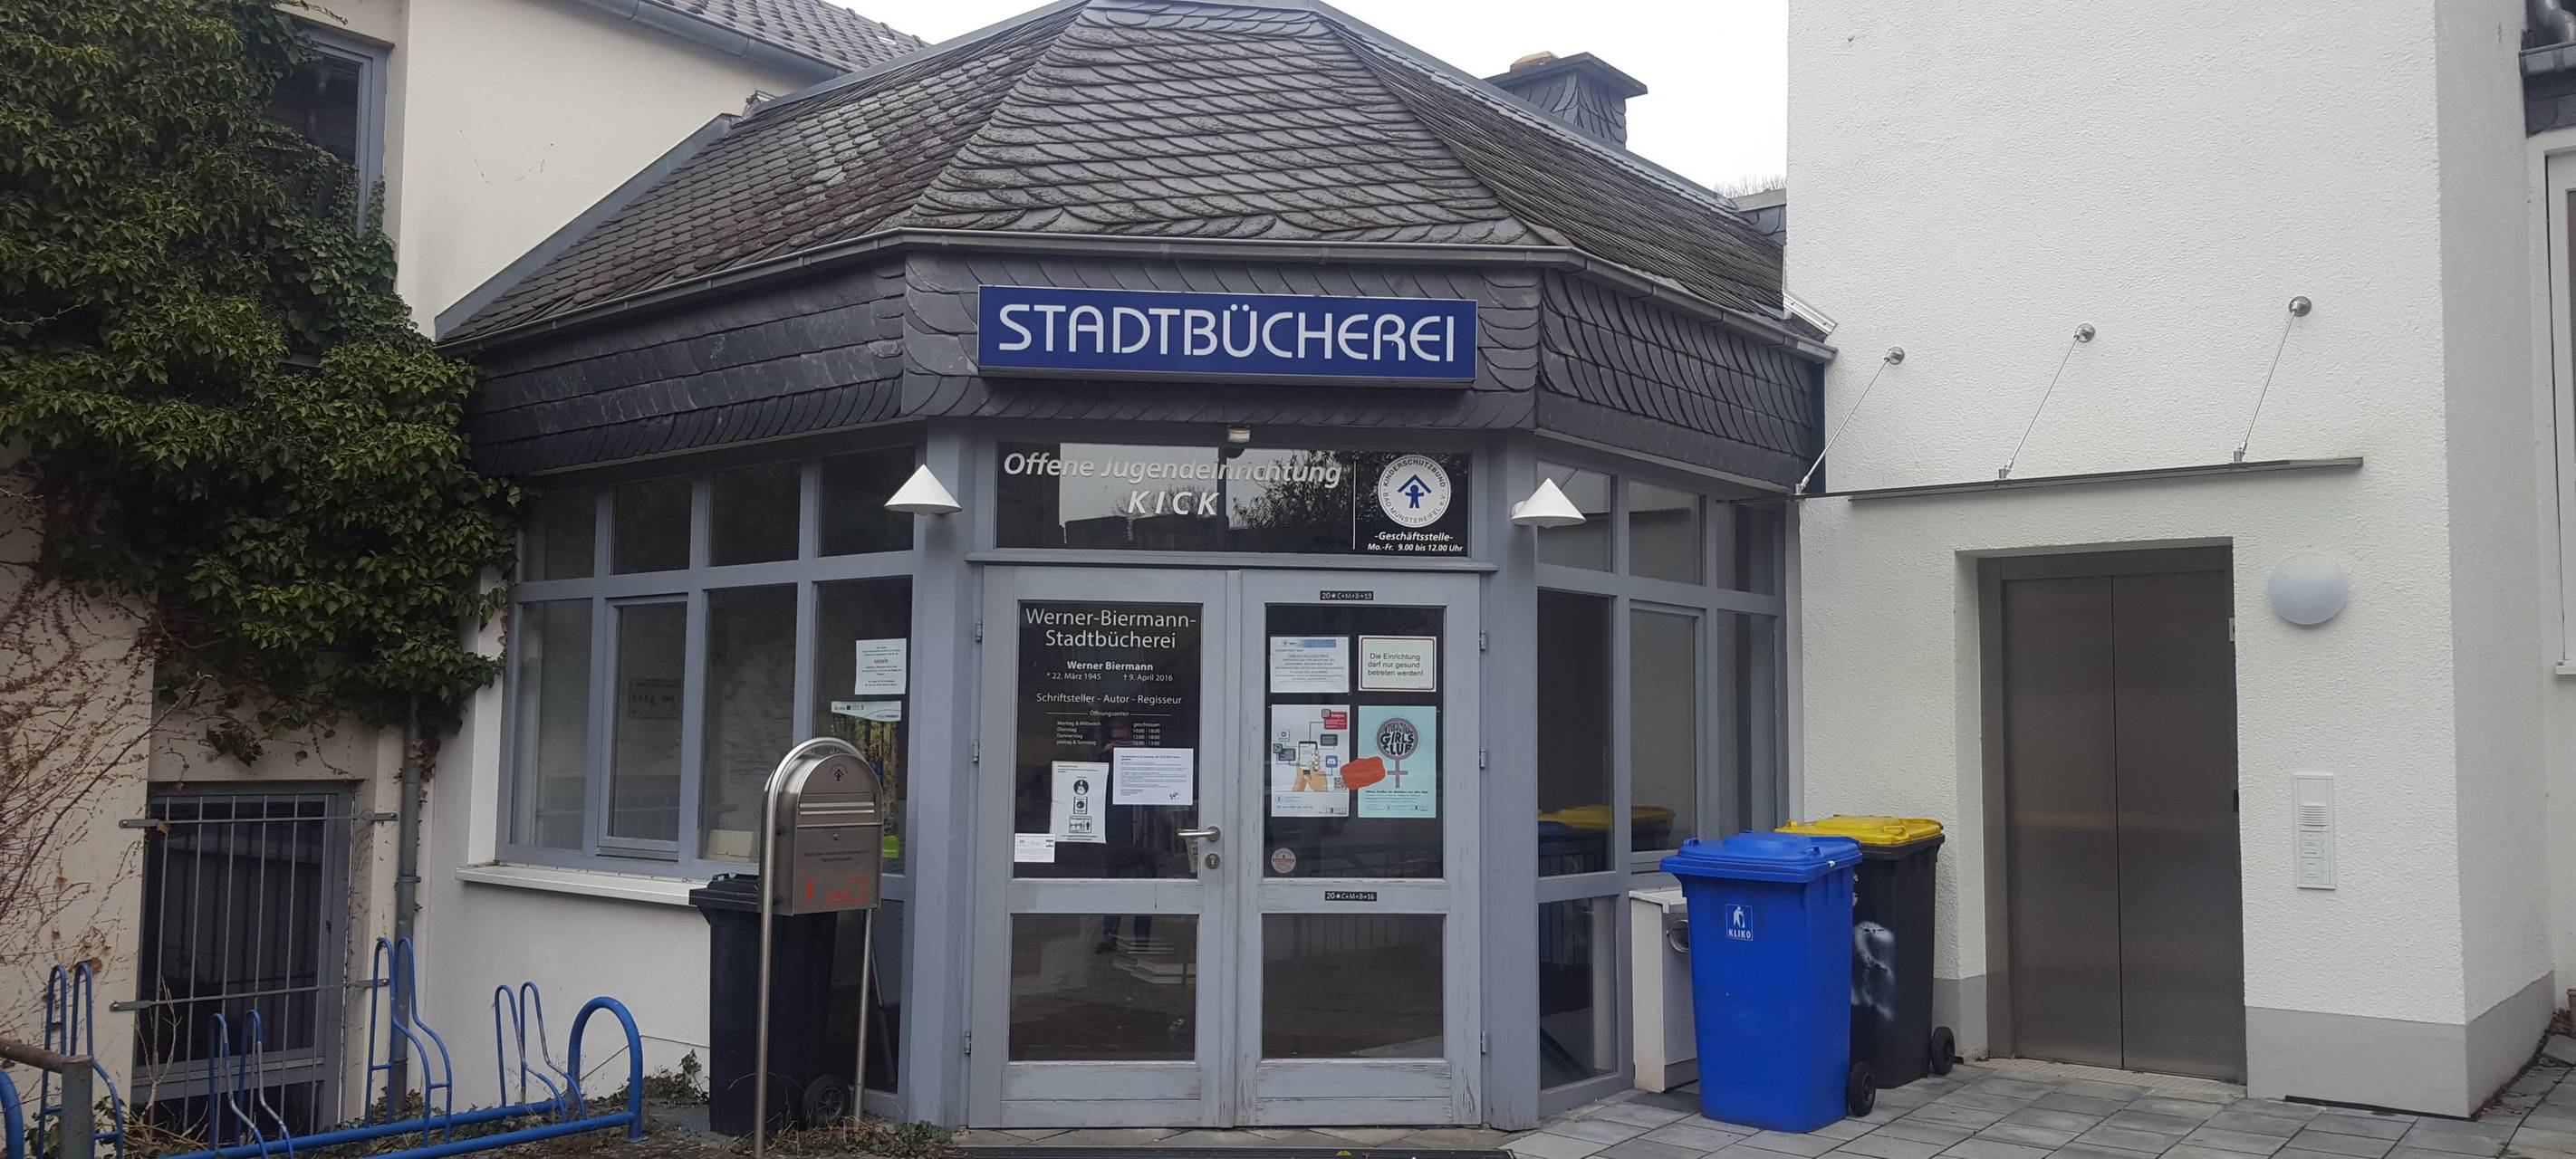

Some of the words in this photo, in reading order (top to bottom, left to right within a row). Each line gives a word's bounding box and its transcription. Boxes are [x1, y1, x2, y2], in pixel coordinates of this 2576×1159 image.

[998, 303, 1455, 362] STADTBÜCHEREI
[1004, 453, 1094, 476] Offene
[1100, 456, 1342, 489] Jugendeinrichtung
[1383, 458, 1446, 487] KINDERSCHUTZBUND
[1127, 490, 1220, 516] KICK
[1415, 543, 1426, 551] bis
[1428, 543, 1447, 551] 12.00
[1025, 608, 1197, 627] Werner-Biermann-
[1045, 629, 1176, 648] Stadtbücherei
[1383, 653, 1421, 662] Einrichtung
[1066, 661, 1103, 670] Werner
[1105, 661, 1154, 671] Biermann
[1395, 661, 1420, 670] gesund
[1137, 674, 1154, 682] April
[1396, 669, 1424, 677] werden!
[1036, 693, 1095, 703] Schriftsteller
[1103, 694, 1129, 704] Autor
[1137, 694, 1182, 705] Regisseur
[1380, 731, 1415, 745] GIRLS
[1728, 928, 1752, 939] KLIKO
